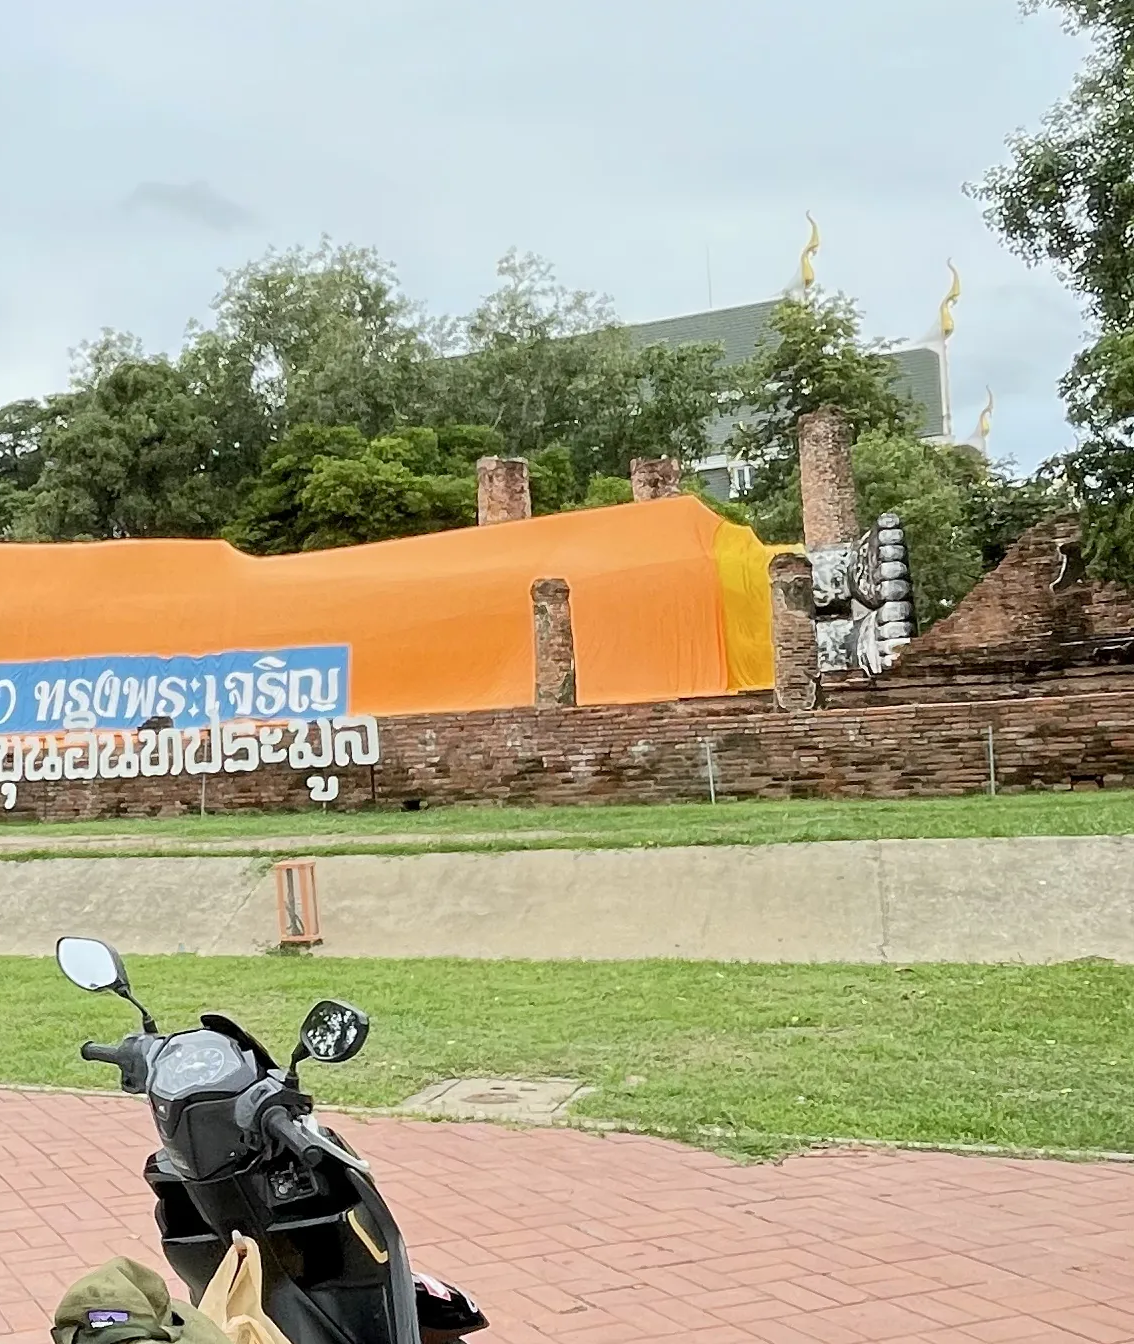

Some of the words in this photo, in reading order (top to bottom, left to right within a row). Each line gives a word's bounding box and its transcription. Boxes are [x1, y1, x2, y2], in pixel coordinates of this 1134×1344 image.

[34, 656, 341, 722] ทรงพระเจริญ
